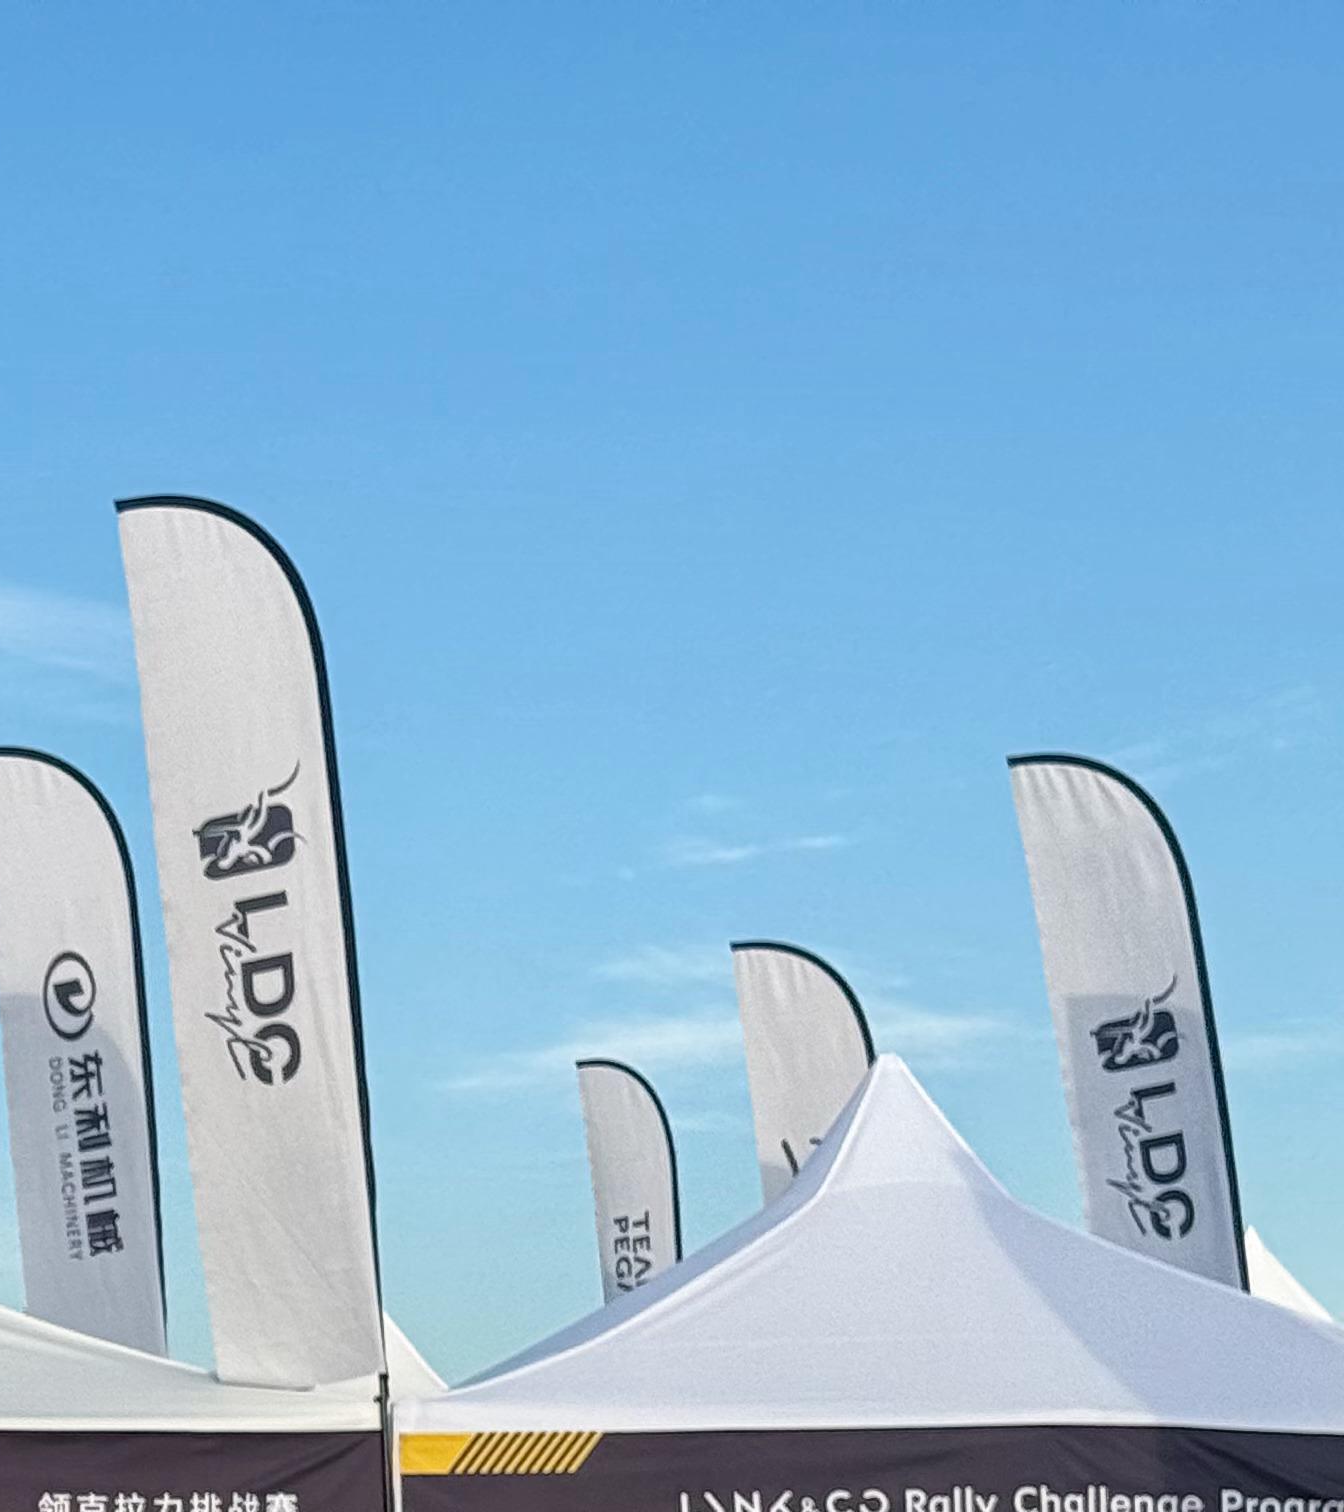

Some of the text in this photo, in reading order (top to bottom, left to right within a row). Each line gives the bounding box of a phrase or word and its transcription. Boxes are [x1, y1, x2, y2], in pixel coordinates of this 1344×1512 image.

[234, 890, 301, 1086] LDC
[49, 1056, 67, 1113] DONG
[60, 1152, 83, 1261] MACHINERY
